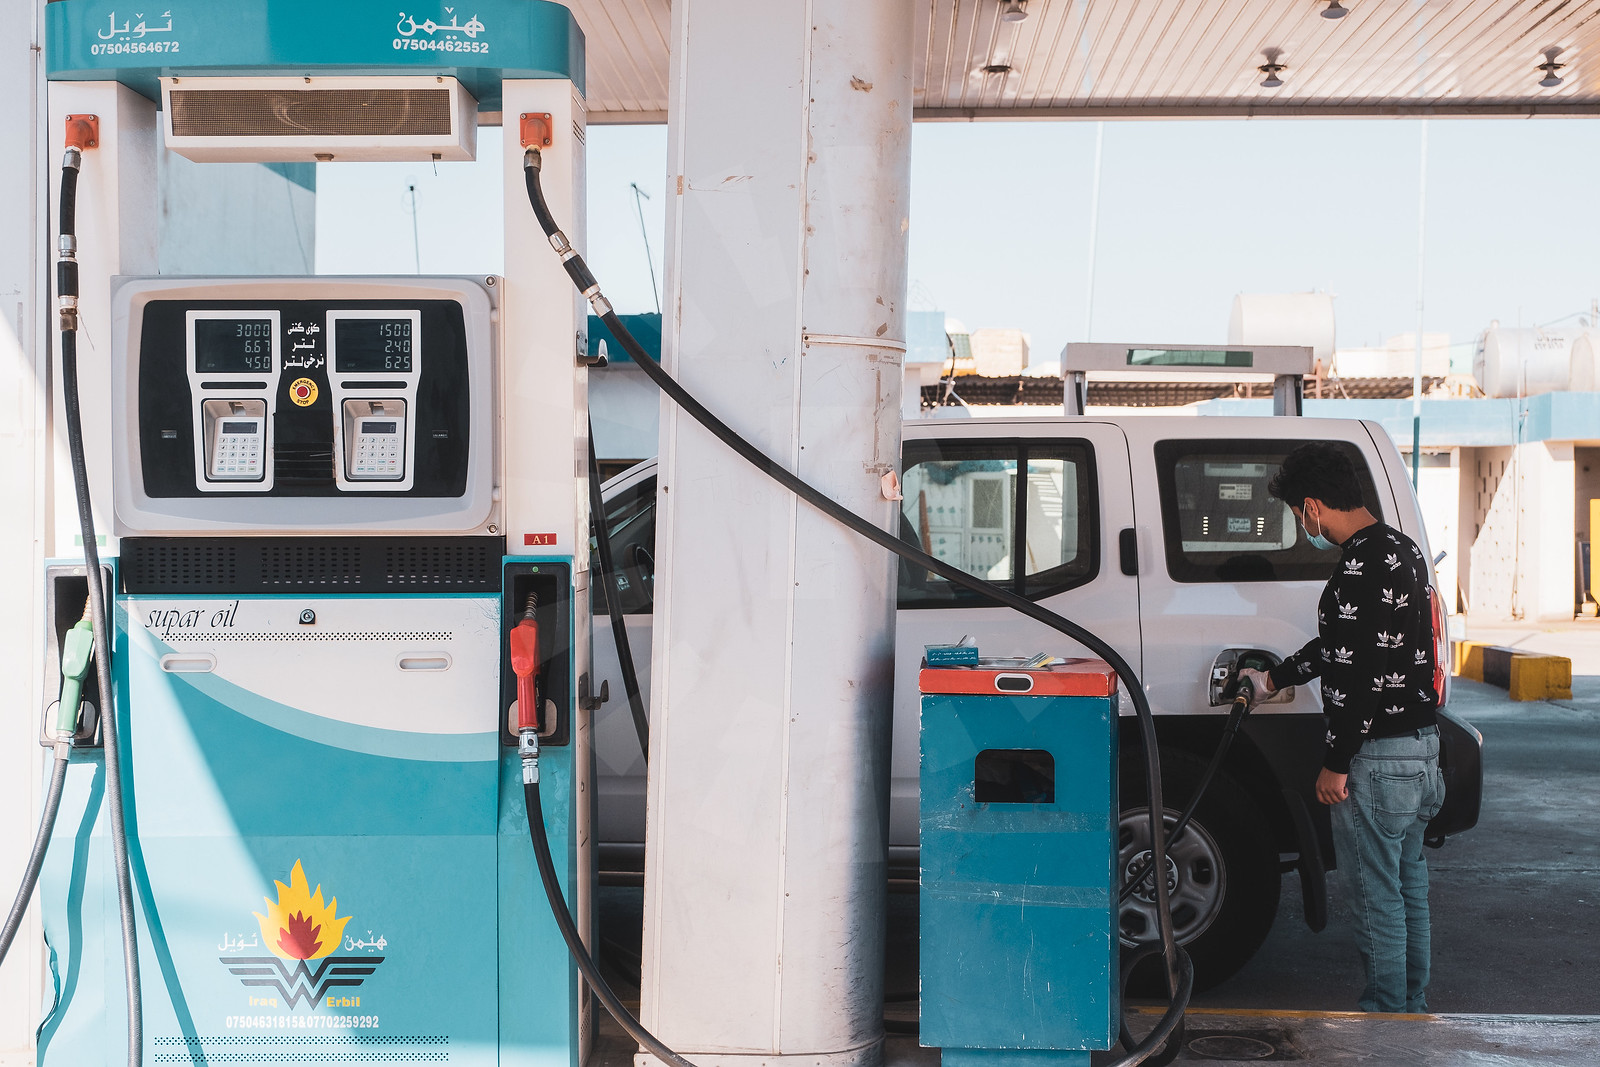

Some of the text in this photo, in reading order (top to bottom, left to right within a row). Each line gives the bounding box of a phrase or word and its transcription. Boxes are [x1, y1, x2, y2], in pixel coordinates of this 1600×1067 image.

[90, 41, 180, 55] 07504564672
[392, 38, 490, 54] 07504462552
[236, 323, 271, 337] 3000
[379, 323, 411, 337] 1500
[244, 339, 271, 353] 6.67
[384, 339, 411, 353] 2.40
[245, 356, 271, 369] 450
[384, 355, 411, 369] 625
[291, 379, 316, 391] EMERGENCY
[144, 599, 240, 635] supar oil
[248, 995, 278, 1009] Iraq
[326, 996, 361, 1008] Erbil
[225, 1015, 380, 1029] 07504631815&07702259292
